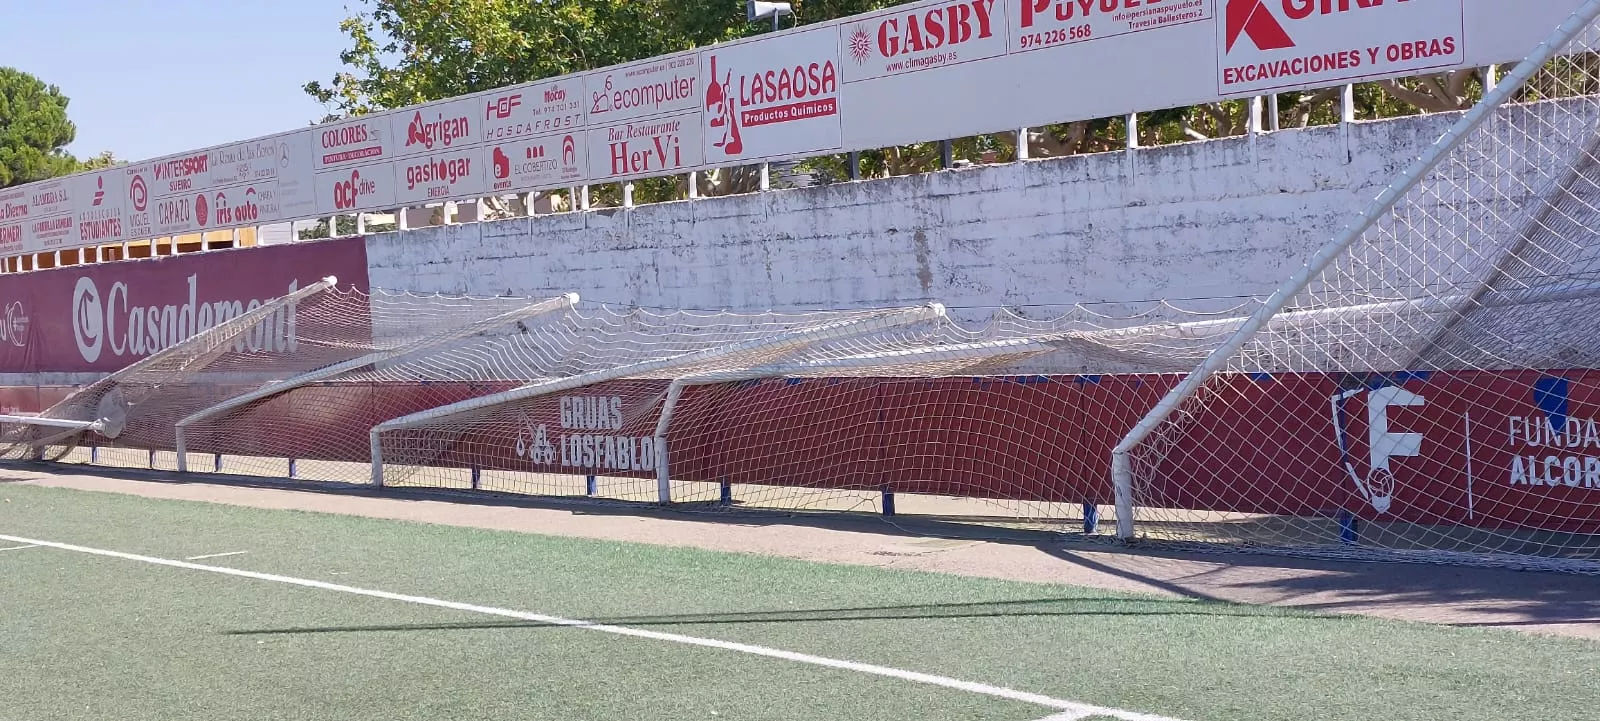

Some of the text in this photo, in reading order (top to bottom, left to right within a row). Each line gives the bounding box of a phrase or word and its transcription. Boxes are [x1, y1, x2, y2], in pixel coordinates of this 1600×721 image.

[877, 0, 995, 58] GASBY
[1158, 11, 1197, 24] Ballesteros
[1198, 9, 1203, 17] 2
[1020, 24, 1091, 49] 974 226 568
[886, 51, 958, 72] www.climagasby.es
[1223, 36, 1456, 85] EXCAVACIONES Y OBRAS
[613, 74, 696, 110] ecomputer
[740, 59, 836, 107] LASAOSA
[405, 111, 469, 149] Agrigan
[486, 113, 581, 140] HOSCAFROST
[744, 110, 788, 123] Productos
[322, 123, 368, 149] COLORES
[608, 120, 680, 142] Bar Restaurante
[161, 154, 208, 181] INTERSPORT
[610, 134, 681, 175] HerVi
[358, 178, 376, 196] drive
[406, 157, 471, 190] gashogar
[158, 198, 190, 225] CAPAZO
[216, 197, 257, 225] iris auto
[80, 219, 121, 240] ESTUDIANTES
[560, 396, 622, 430] GRUAS
